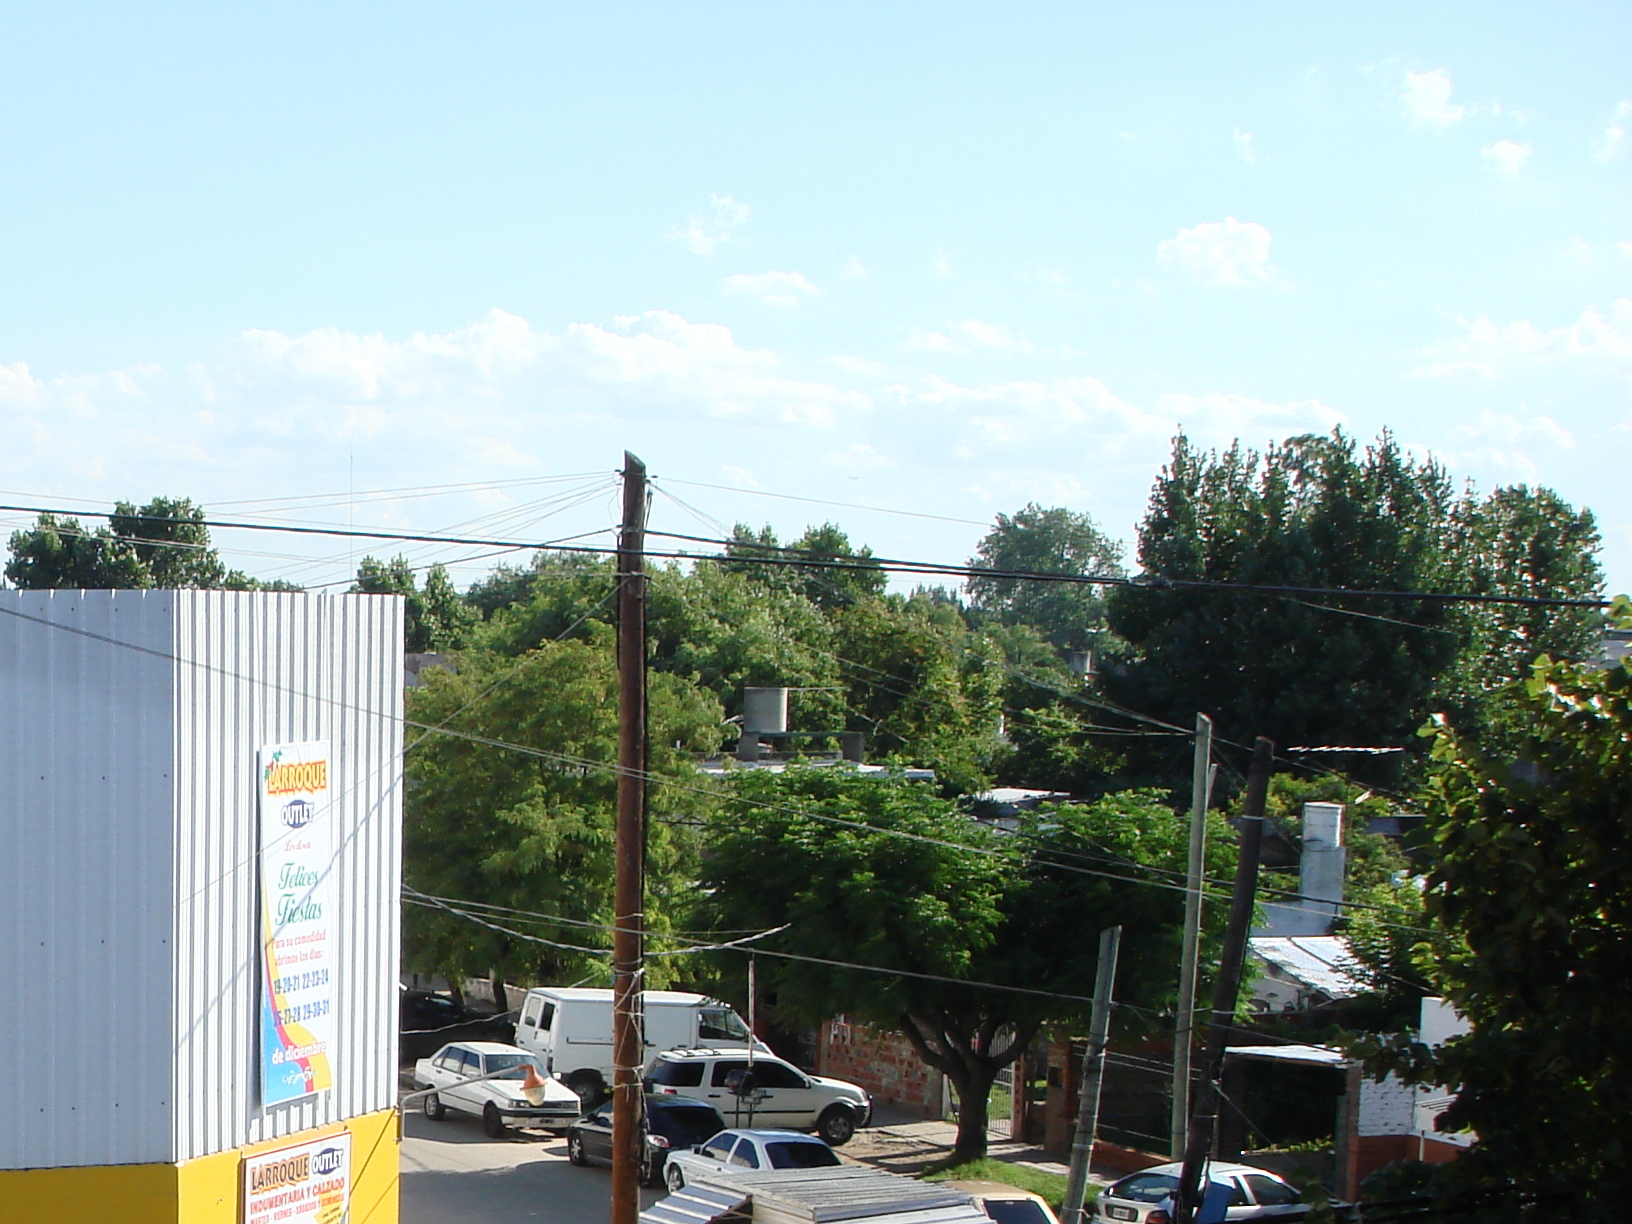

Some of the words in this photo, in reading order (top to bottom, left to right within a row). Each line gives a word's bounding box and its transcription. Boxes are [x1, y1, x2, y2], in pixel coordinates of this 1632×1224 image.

[268, 760, 327, 795] LARROQUE
[281, 803, 315, 828] OUTLET
[278, 861, 319, 890] Felices
[275, 893, 322, 926] Fiestas
[272, 1047, 284, 1065] de
[285, 1040, 327, 1062] diciembre
[250, 1153, 310, 1195] LARROQUE
[311, 1149, 343, 1175] OUTLET
[250, 1189, 305, 1214] INDUMENTARIA
[312, 1177, 345, 1196] CALZADO
